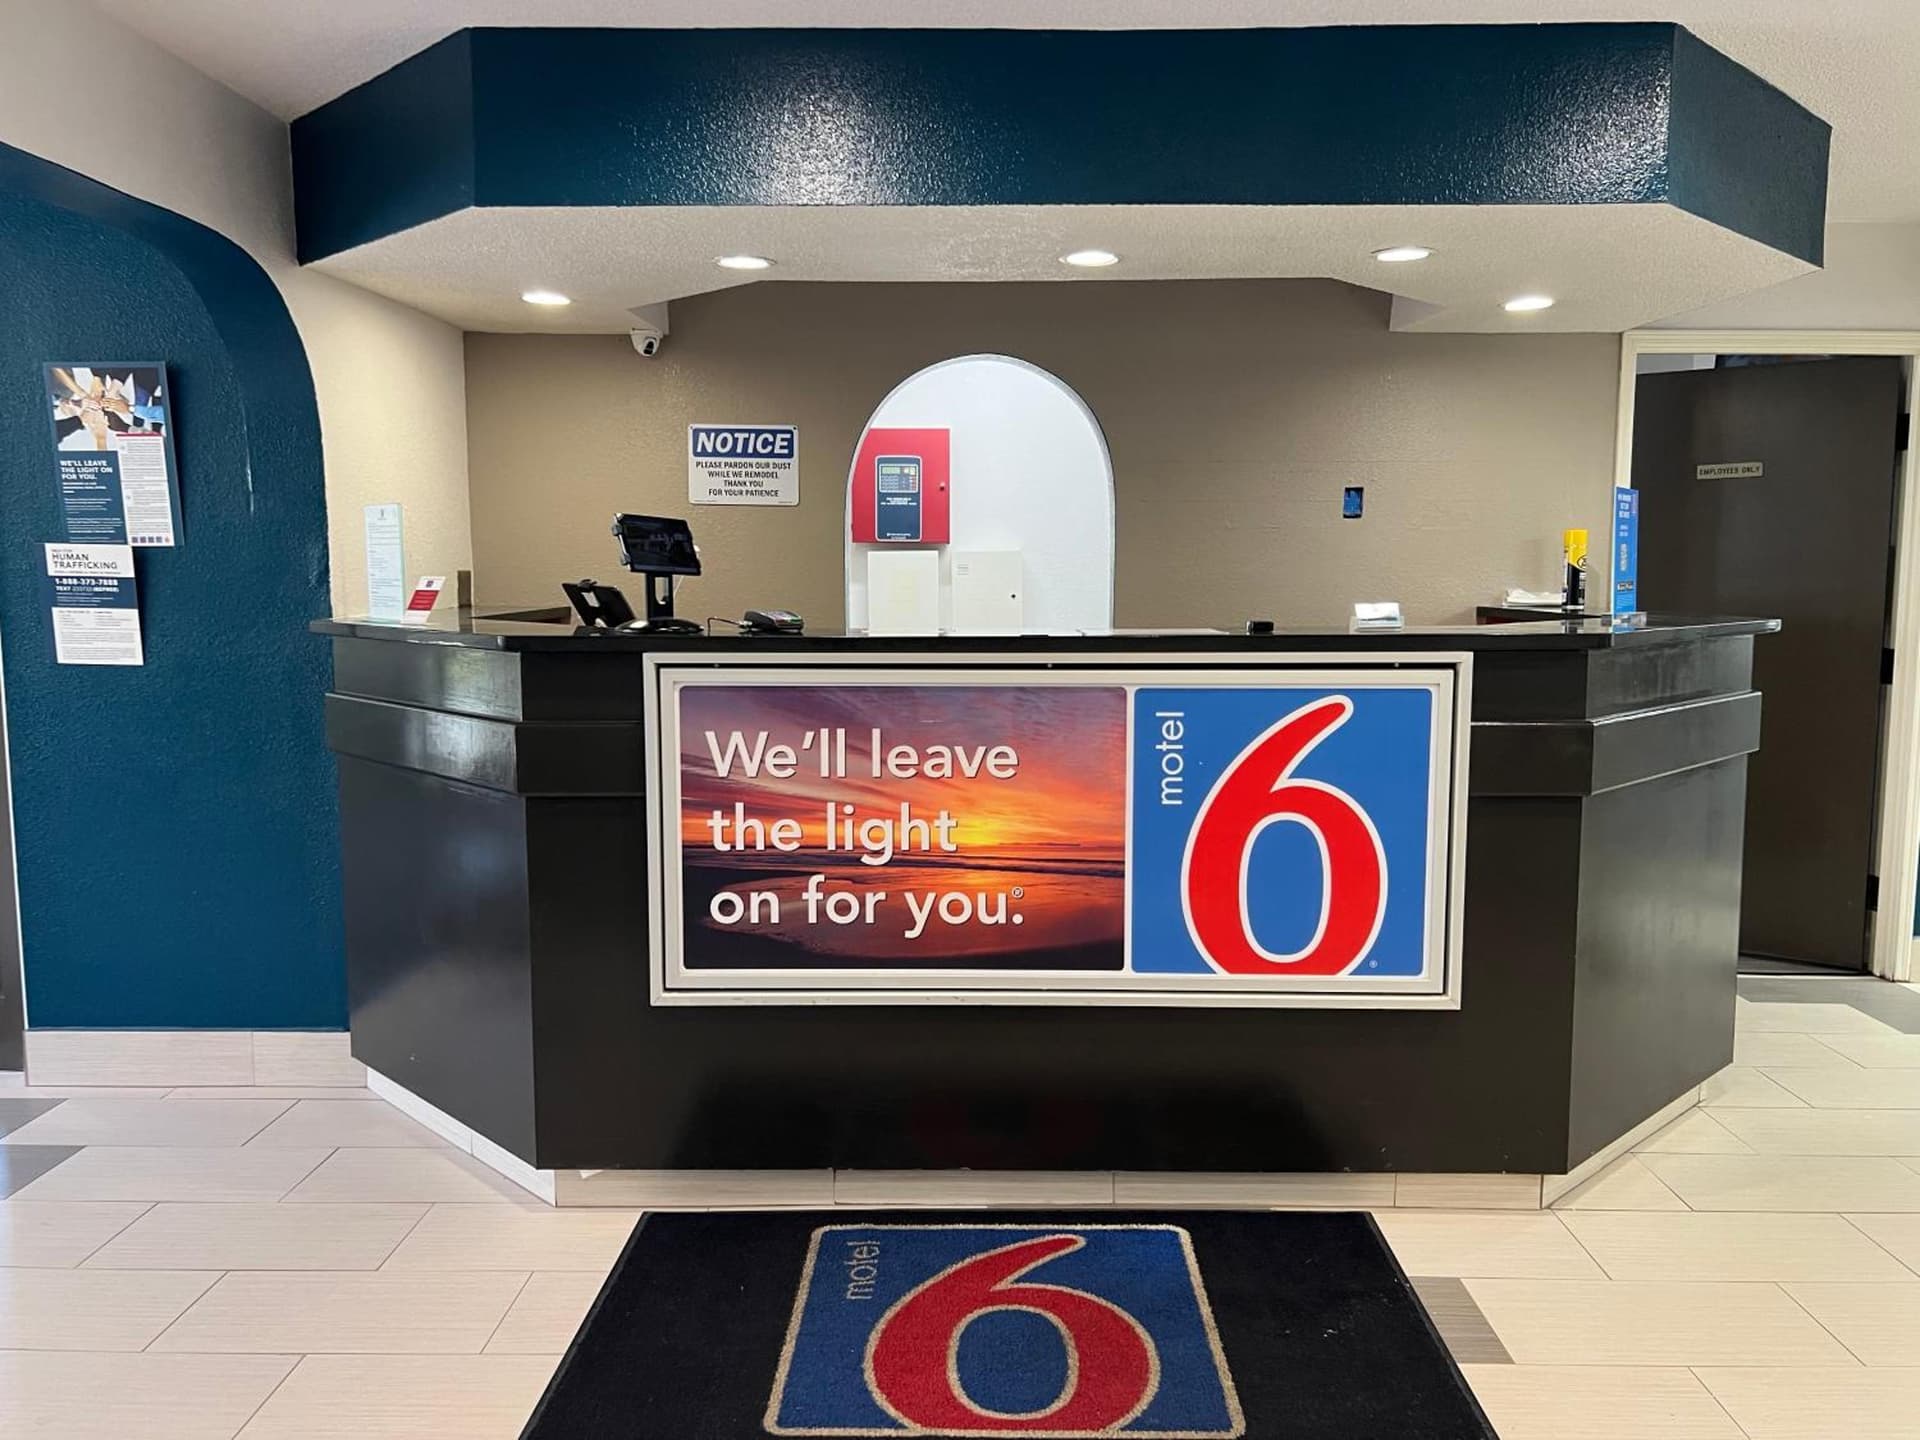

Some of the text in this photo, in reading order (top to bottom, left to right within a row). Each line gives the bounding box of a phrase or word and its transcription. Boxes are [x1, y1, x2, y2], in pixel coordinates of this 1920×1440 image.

[696, 432, 791, 454] NOTICE
[696, 461, 722, 469] PLEASE
[755, 462, 770, 470] OUR
[772, 462, 791, 470] DUST
[707, 470, 731, 478] WHILE
[744, 471, 779, 479] REMODEL
[1699, 465, 1761, 476] EMPLOYEES ONLY
[724, 489, 744, 497] YOUR
[745, 489, 779, 497] PATIENCE
[52, 553, 89, 561] HUMAN
[53, 561, 118, 569] TRAFFICKING
[705, 727, 1019, 778] We'll leave
[1155, 711, 1185, 805] motel
[706, 801, 959, 866] the light
[1180, 694, 1388, 976] 6
[709, 889, 781, 925] on
[802, 874, 888, 925] for
[843, 1240, 881, 1300] motel
[863, 1233, 1161, 1432] 6
